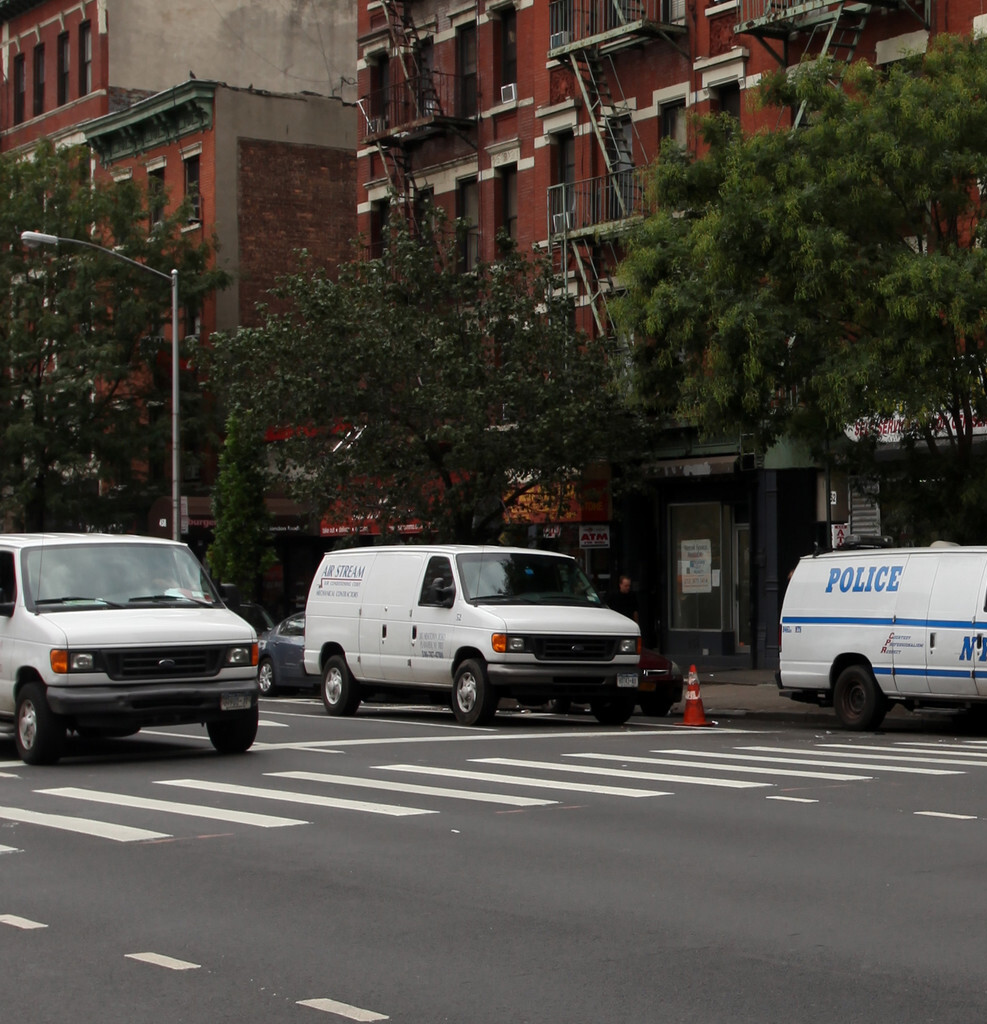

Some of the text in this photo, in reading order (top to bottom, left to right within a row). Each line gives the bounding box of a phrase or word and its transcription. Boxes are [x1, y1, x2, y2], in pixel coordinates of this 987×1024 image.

[581, 533, 608, 541] ATM
[322, 564, 366, 578] AIR STREAM
[825, 566, 904, 593] POLICE
